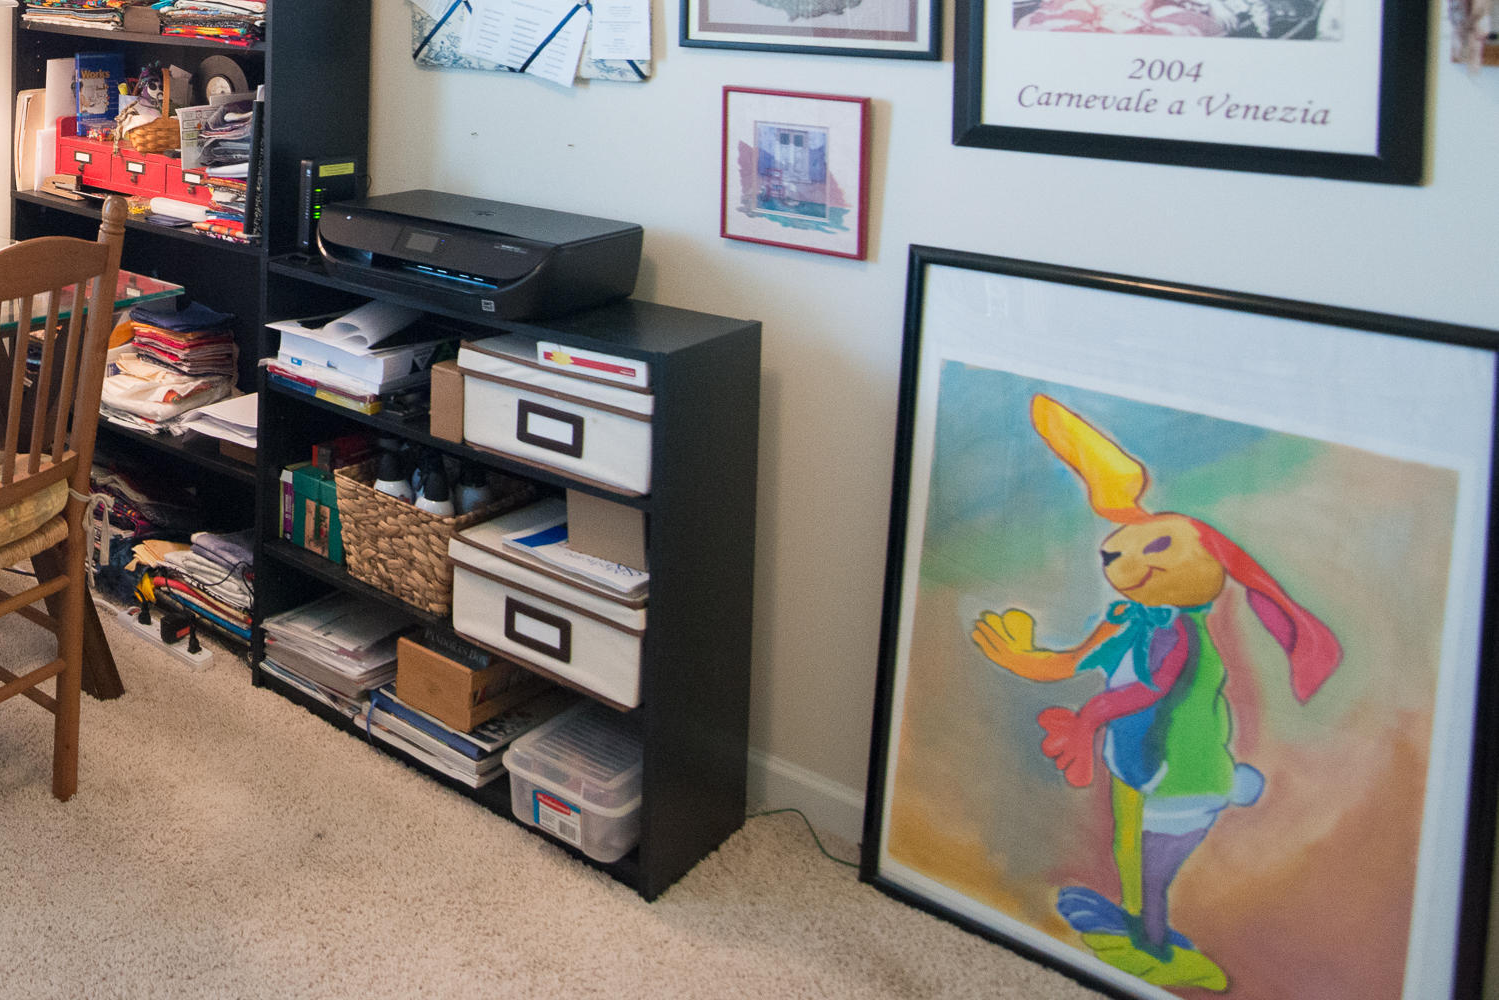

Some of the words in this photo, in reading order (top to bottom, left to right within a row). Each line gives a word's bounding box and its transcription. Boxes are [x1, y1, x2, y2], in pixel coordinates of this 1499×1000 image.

[1128, 57, 1204, 83] 2004
[1017, 84, 1159, 114] Carnevale
[1167, 101, 1186, 116] a
[1197, 94, 1332, 126] Venezia
